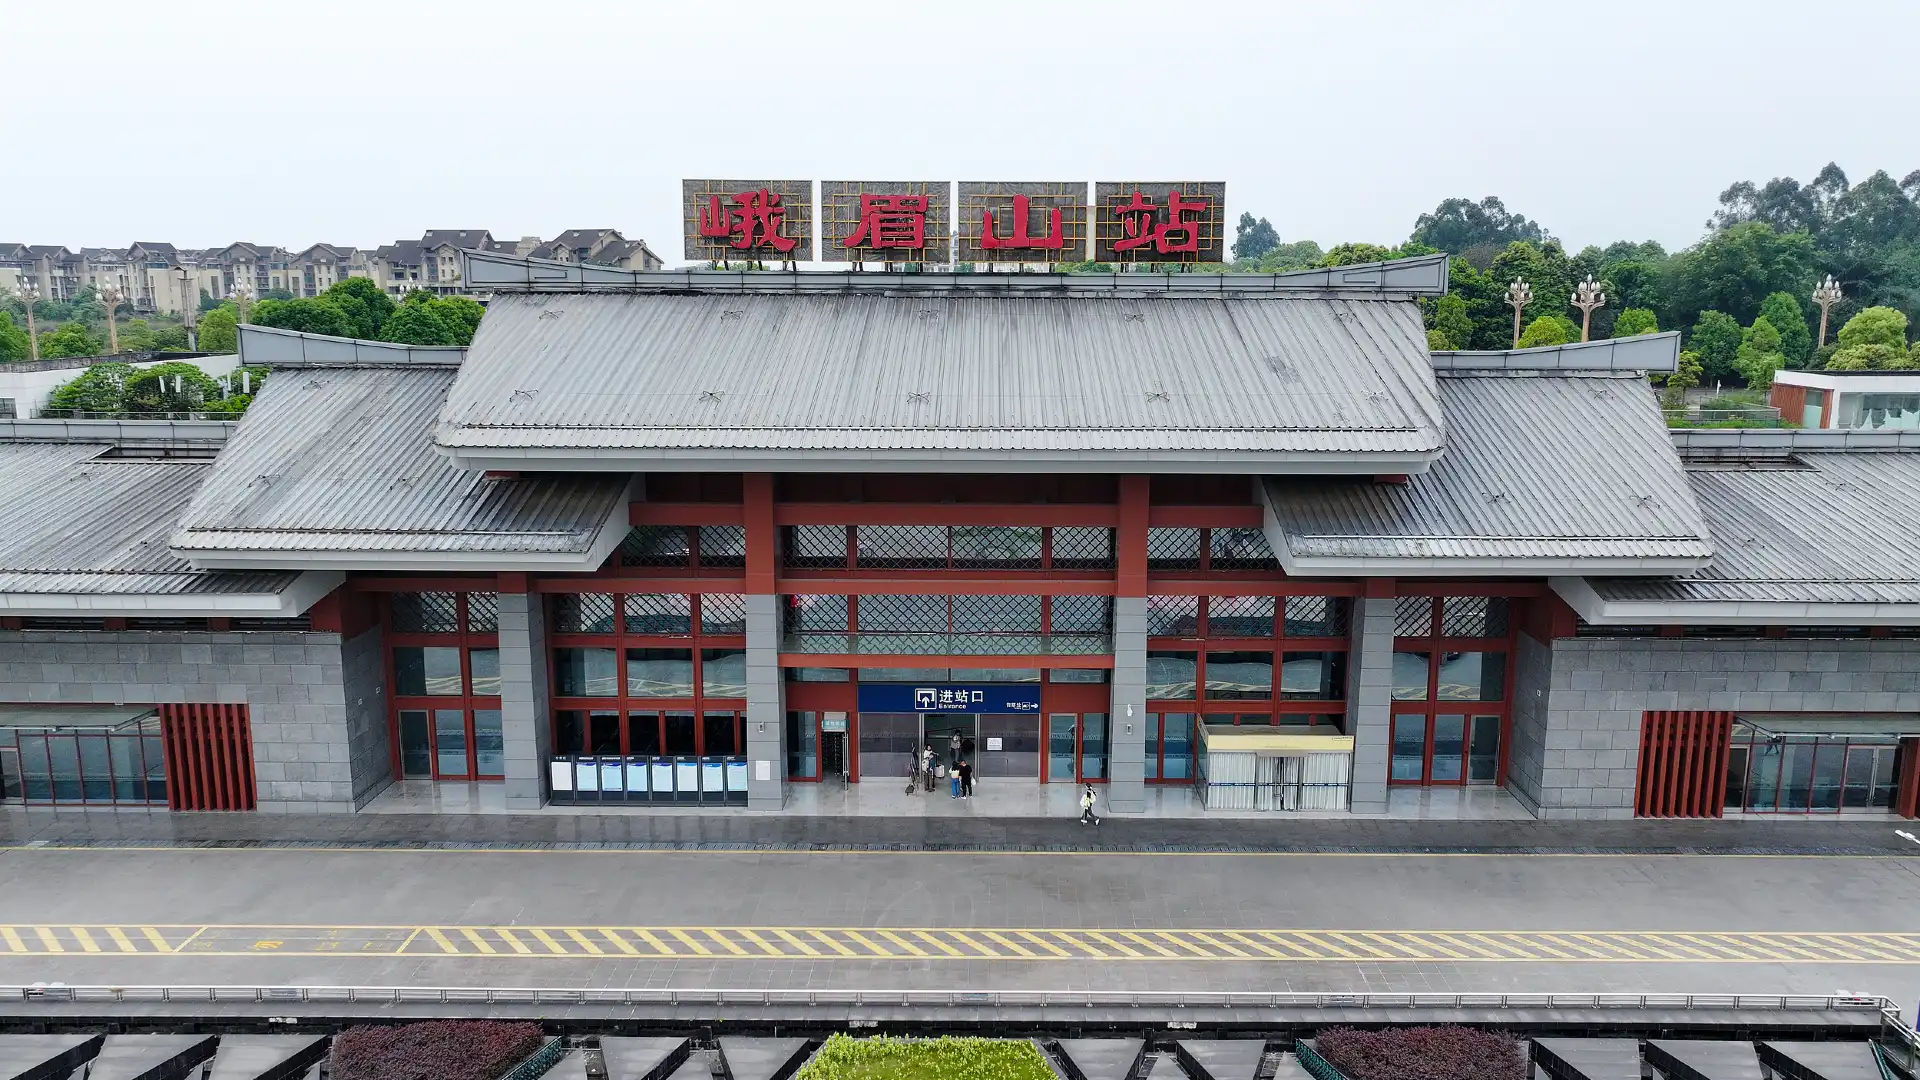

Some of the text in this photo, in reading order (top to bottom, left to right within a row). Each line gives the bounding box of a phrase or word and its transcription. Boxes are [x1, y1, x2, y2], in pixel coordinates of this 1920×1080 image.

[699, 188, 1207, 254] 峨眉山站
[939, 690, 984, 703] 进站口
